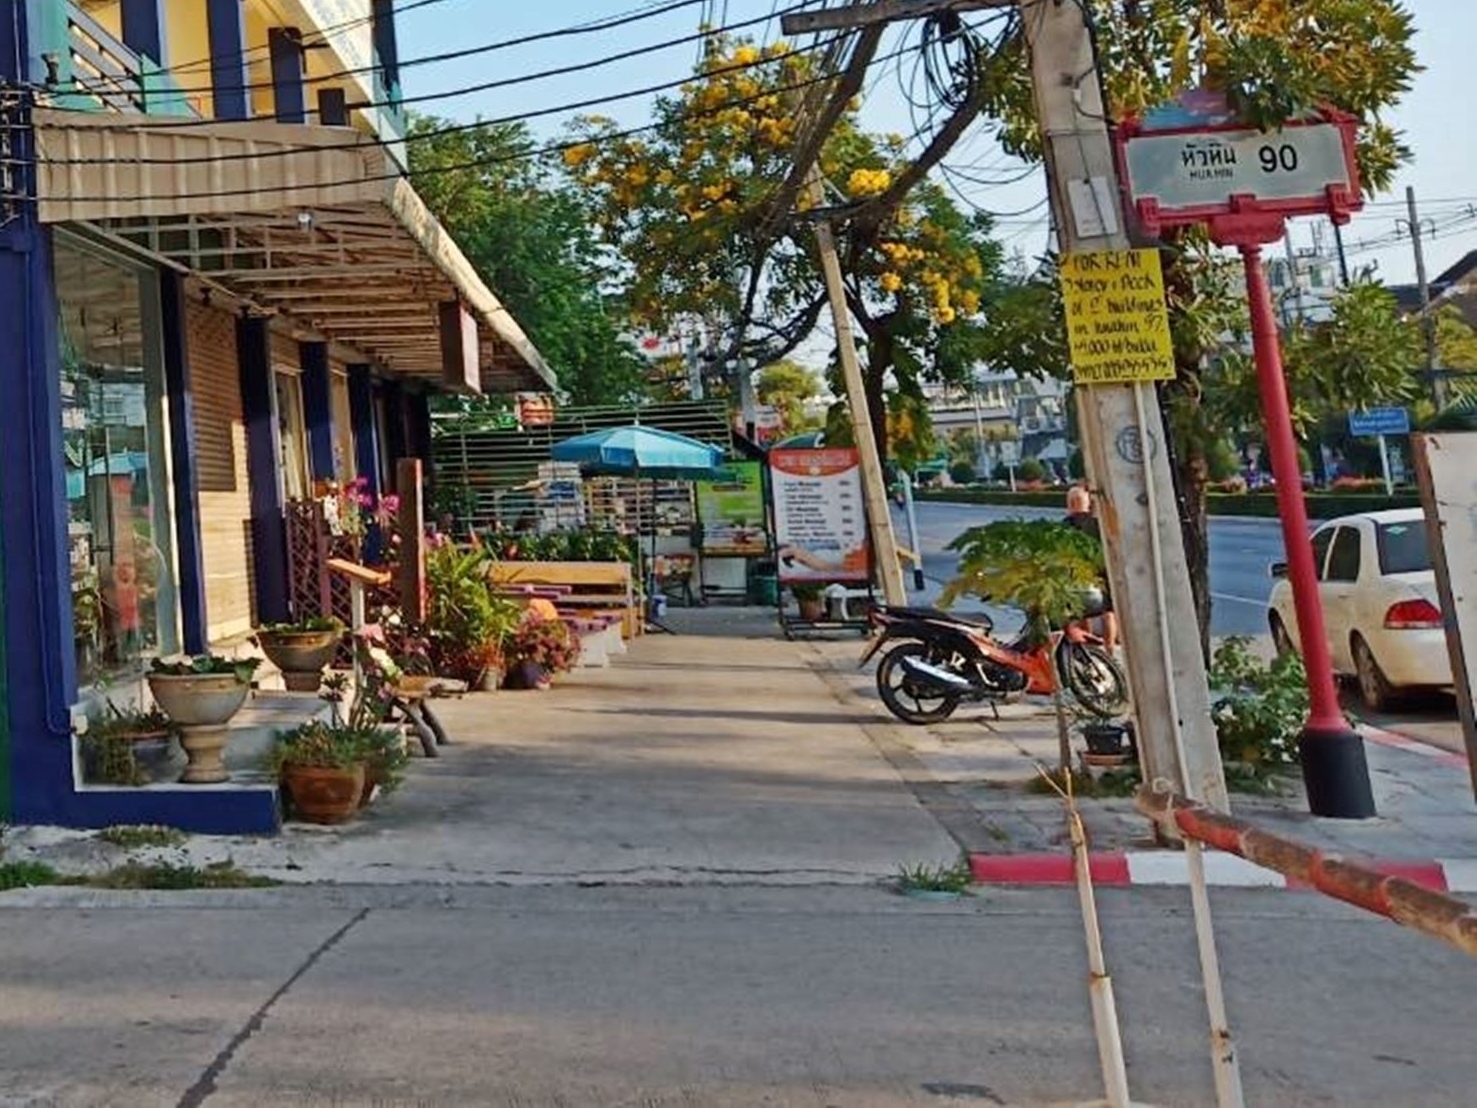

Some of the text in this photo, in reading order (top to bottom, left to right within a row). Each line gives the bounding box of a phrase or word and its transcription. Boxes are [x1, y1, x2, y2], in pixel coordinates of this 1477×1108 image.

[1181, 143, 1298, 173] หัวหิน 90
